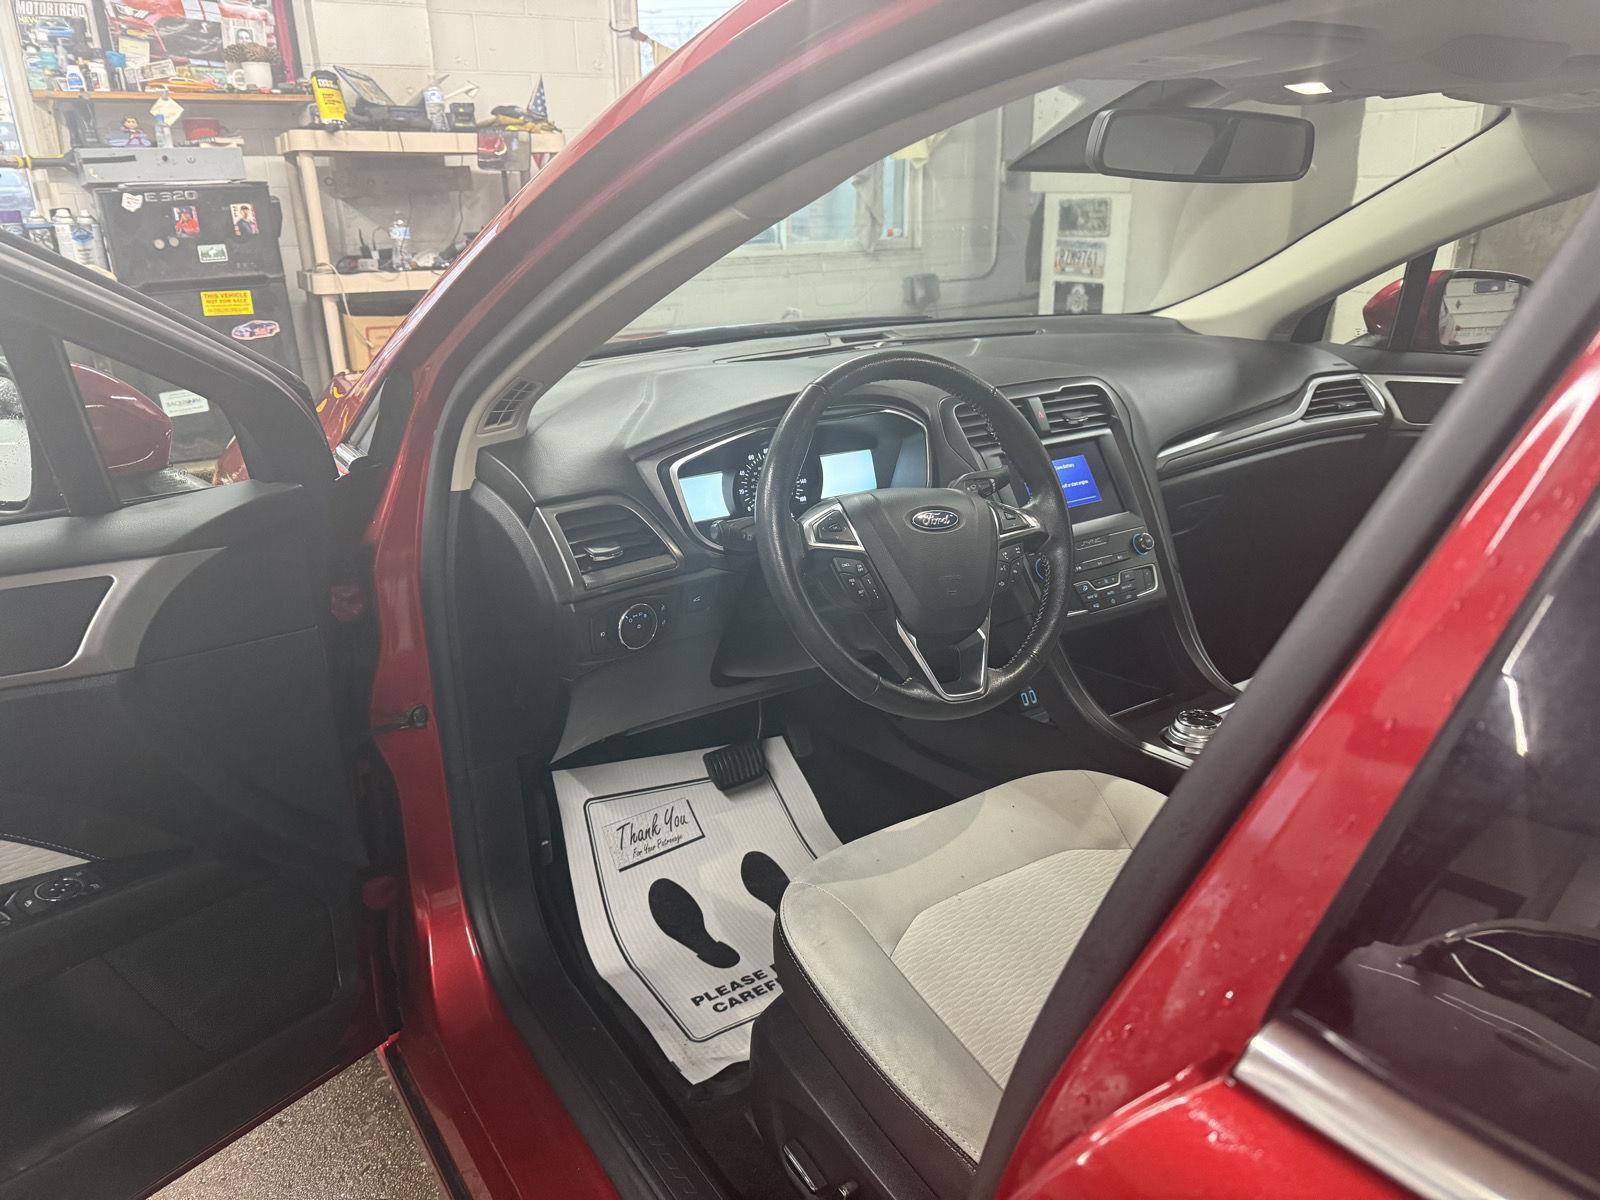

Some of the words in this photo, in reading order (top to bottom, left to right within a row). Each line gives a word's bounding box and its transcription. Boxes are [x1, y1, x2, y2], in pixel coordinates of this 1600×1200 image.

[16, 0, 86, 17] MOTORTREND
[917, 512, 953, 526] Ford
[616, 812, 661, 851] Thank
[664, 806, 688, 832] You
[632, 846, 643, 858] For
[643, 843, 656, 854] Your
[656, 835, 683, 849] Patronage
[690, 969, 768, 1007] PLEASE
[712, 977, 781, 1013] CAREF
